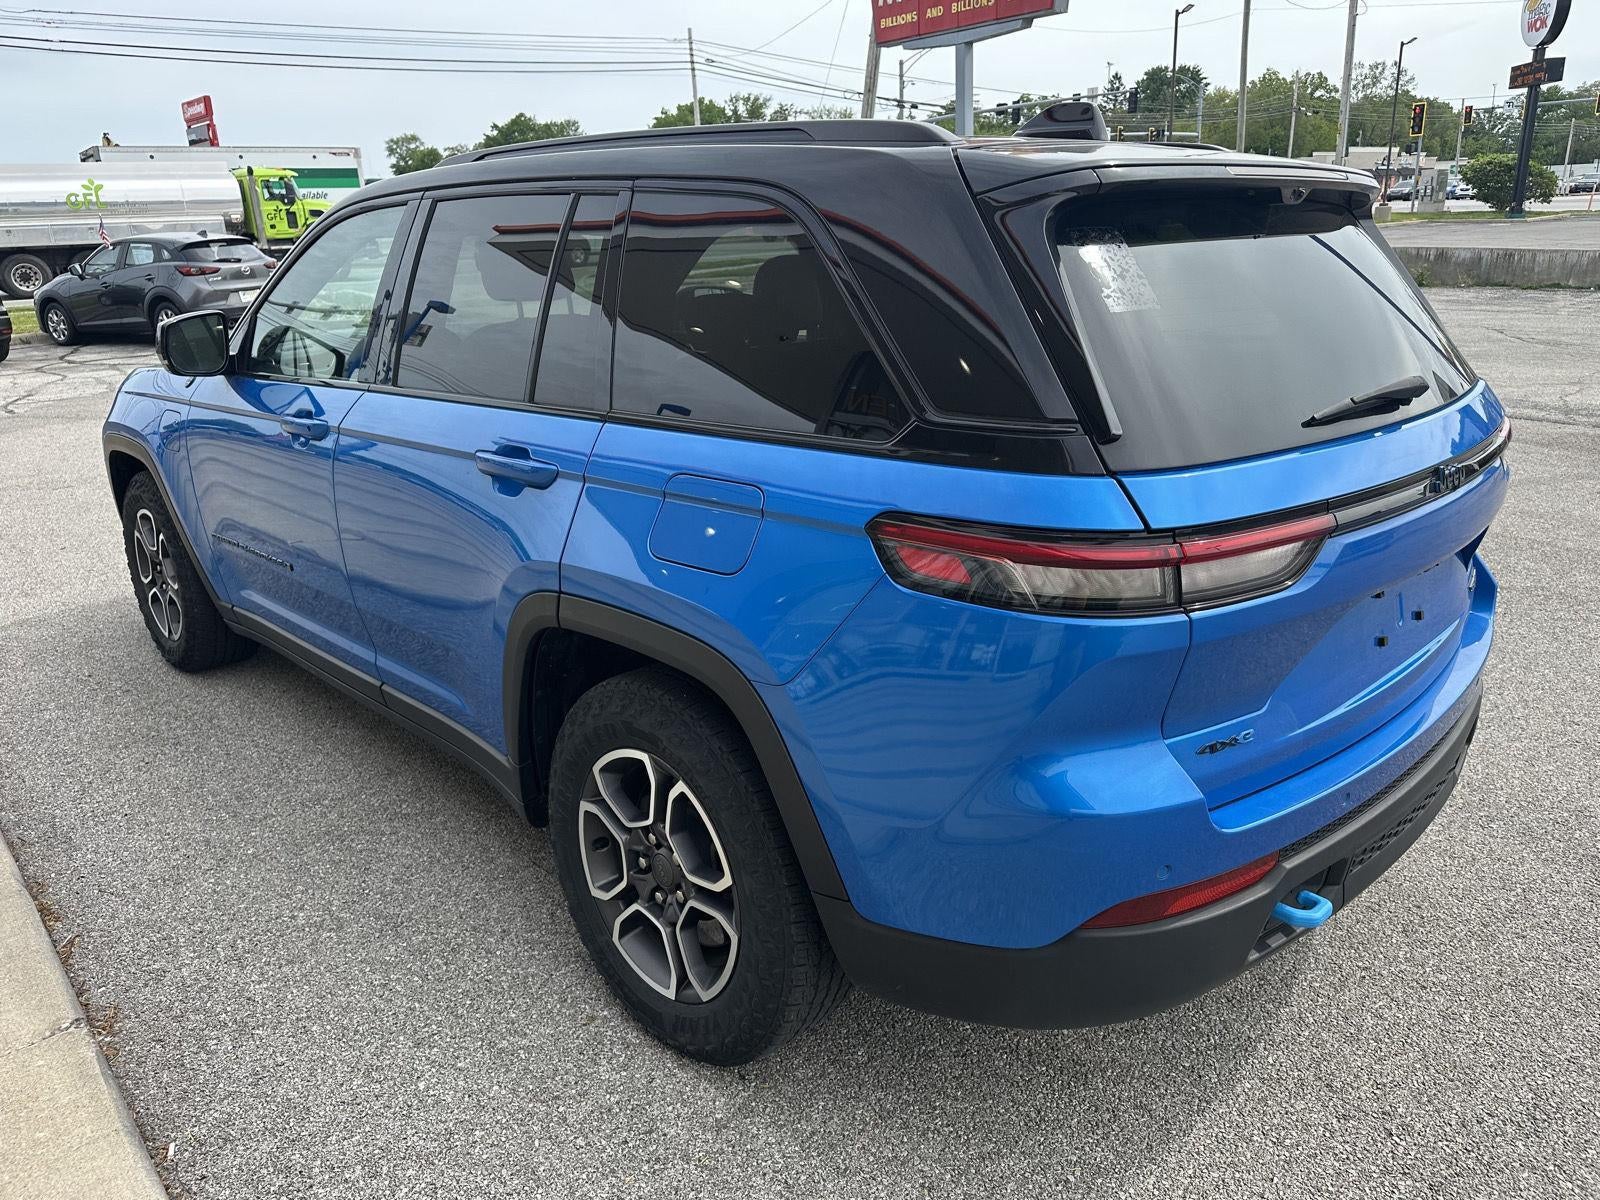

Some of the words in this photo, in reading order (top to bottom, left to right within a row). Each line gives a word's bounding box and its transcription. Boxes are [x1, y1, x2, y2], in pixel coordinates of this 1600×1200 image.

[880, 11, 918, 29] BILLIONS
[926, 5, 944, 19] AND
[951, 0, 995, 13] BILLIONS
[66, 182, 108, 209] GFL
[266, 208, 285, 221] GFL
